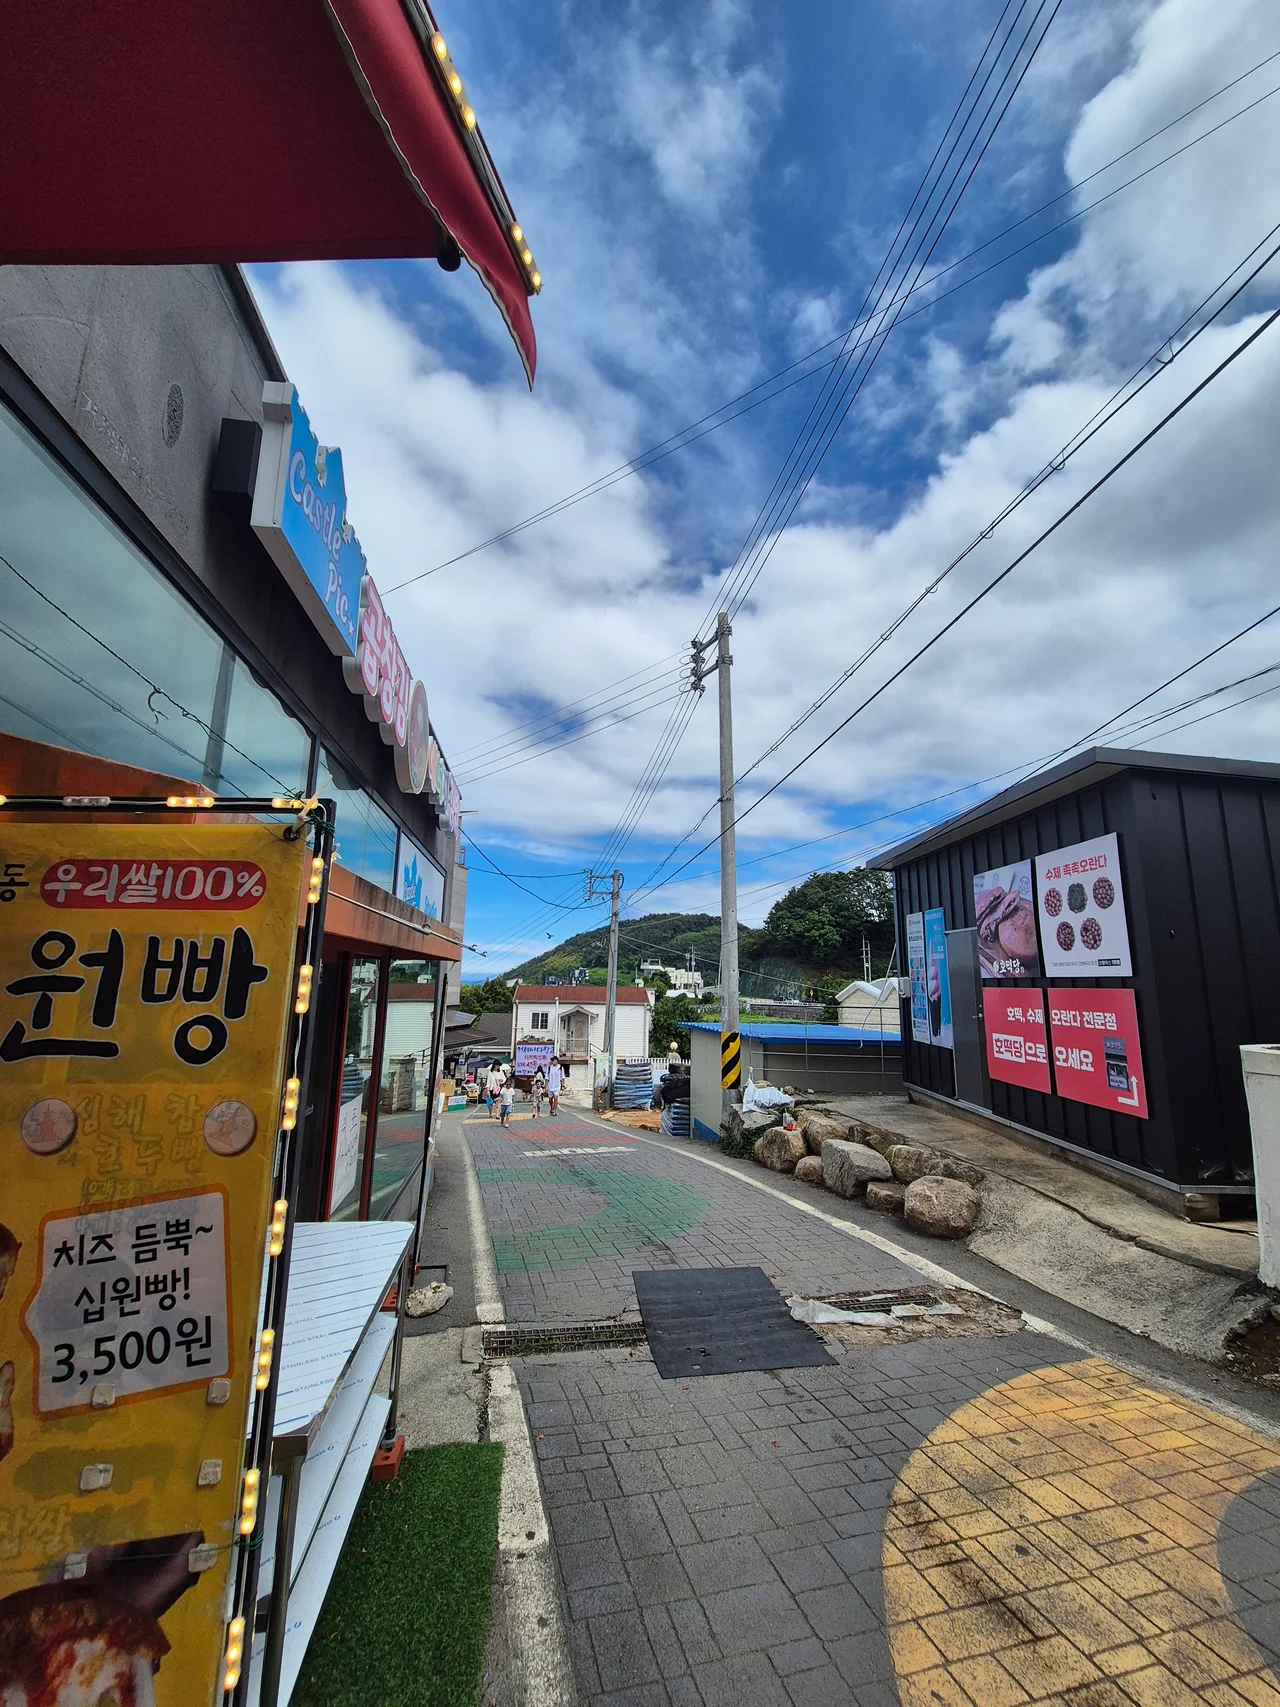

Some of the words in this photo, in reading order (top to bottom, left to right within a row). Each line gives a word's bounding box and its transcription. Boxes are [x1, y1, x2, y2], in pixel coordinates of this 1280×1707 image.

[289, 448, 342, 561] Castle
[324, 560, 349, 623] Pic
[44, 862, 263, 904] 우리쌀100%
[1045, 868, 1062, 881] 수제
[1062, 854, 1108, 877] 촉촉오란다
[1006, 1007, 1026, 1023] 호떡,
[1027, 1012, 1044, 1024] 수제
[1051, 1010, 1081, 1028] 오란다
[1083, 1012, 1117, 1031] 전문점
[994, 1036, 1047, 1064] 호떡당으로
[1055, 1046, 1095, 1072] 오세요
[52, 1234, 117, 1268] 치즈
[131, 1218, 214, 1265] 듬뿍~
[74, 1267, 191, 1324] 십원빵!
[51, 1314, 212, 1385] 3,500원
[281, 1356, 319, 1371] STAINLESS
[293, 1377, 335, 1393] STAINLESS
